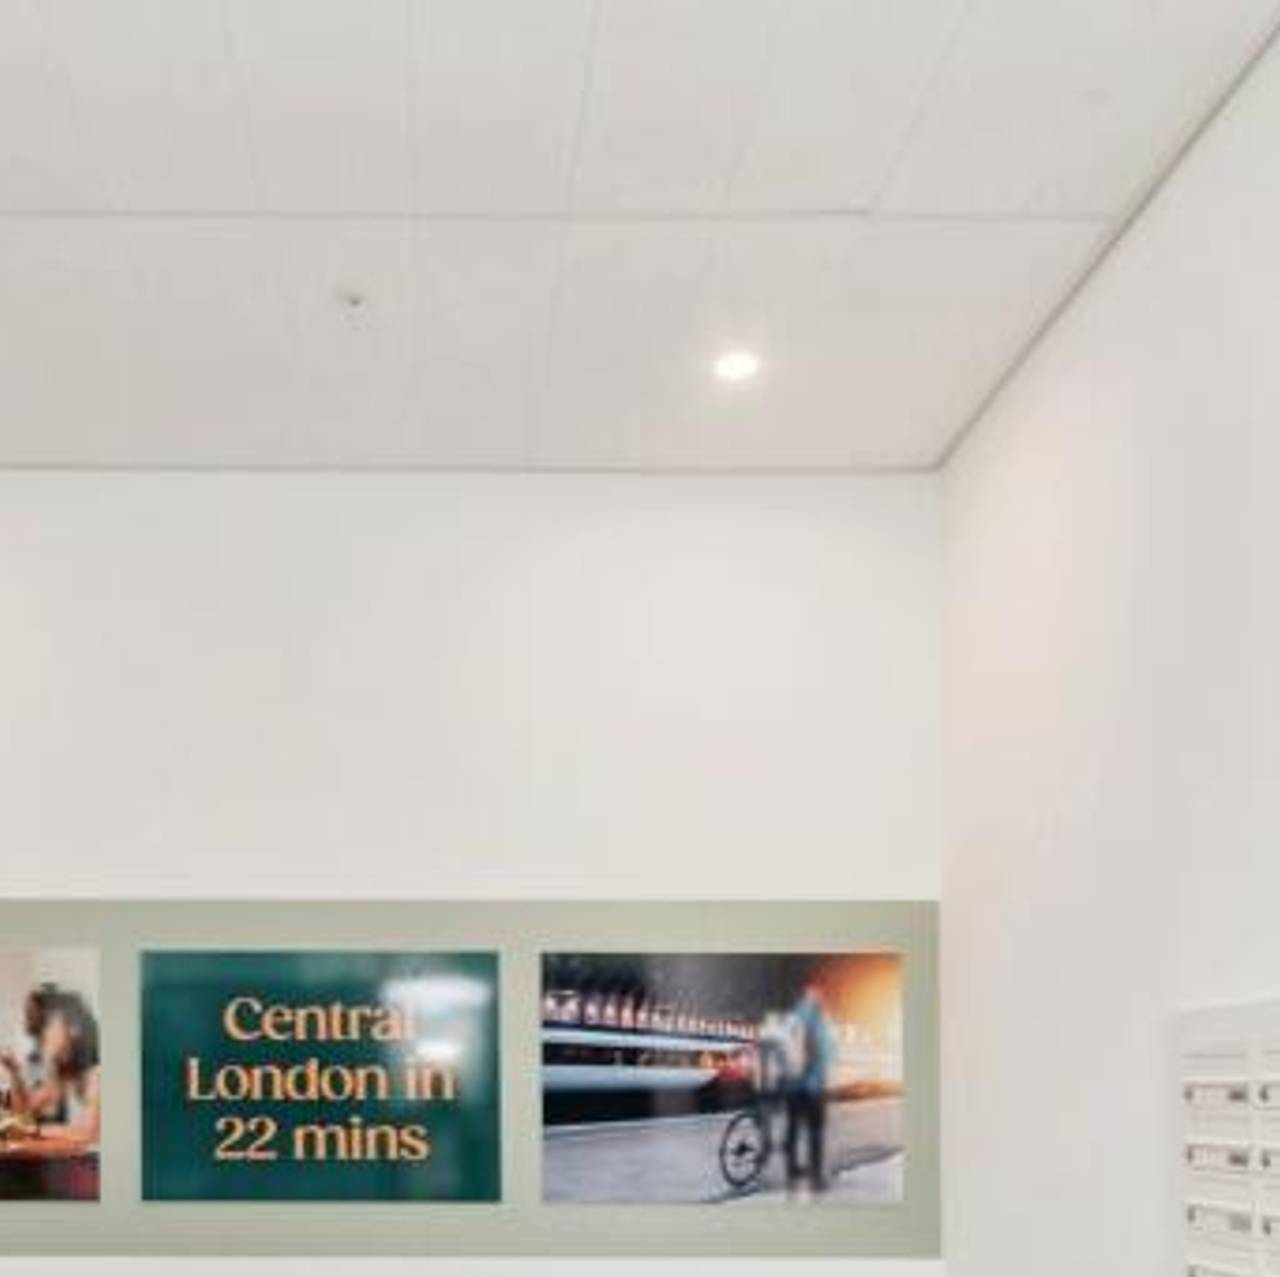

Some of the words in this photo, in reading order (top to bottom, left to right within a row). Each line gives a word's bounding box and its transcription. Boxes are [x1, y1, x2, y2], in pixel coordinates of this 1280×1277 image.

[187, 1056, 388, 1101] London
[405, 1055, 456, 1101] in
[214, 1115, 277, 1160] 22
[294, 1115, 430, 1160] mins
